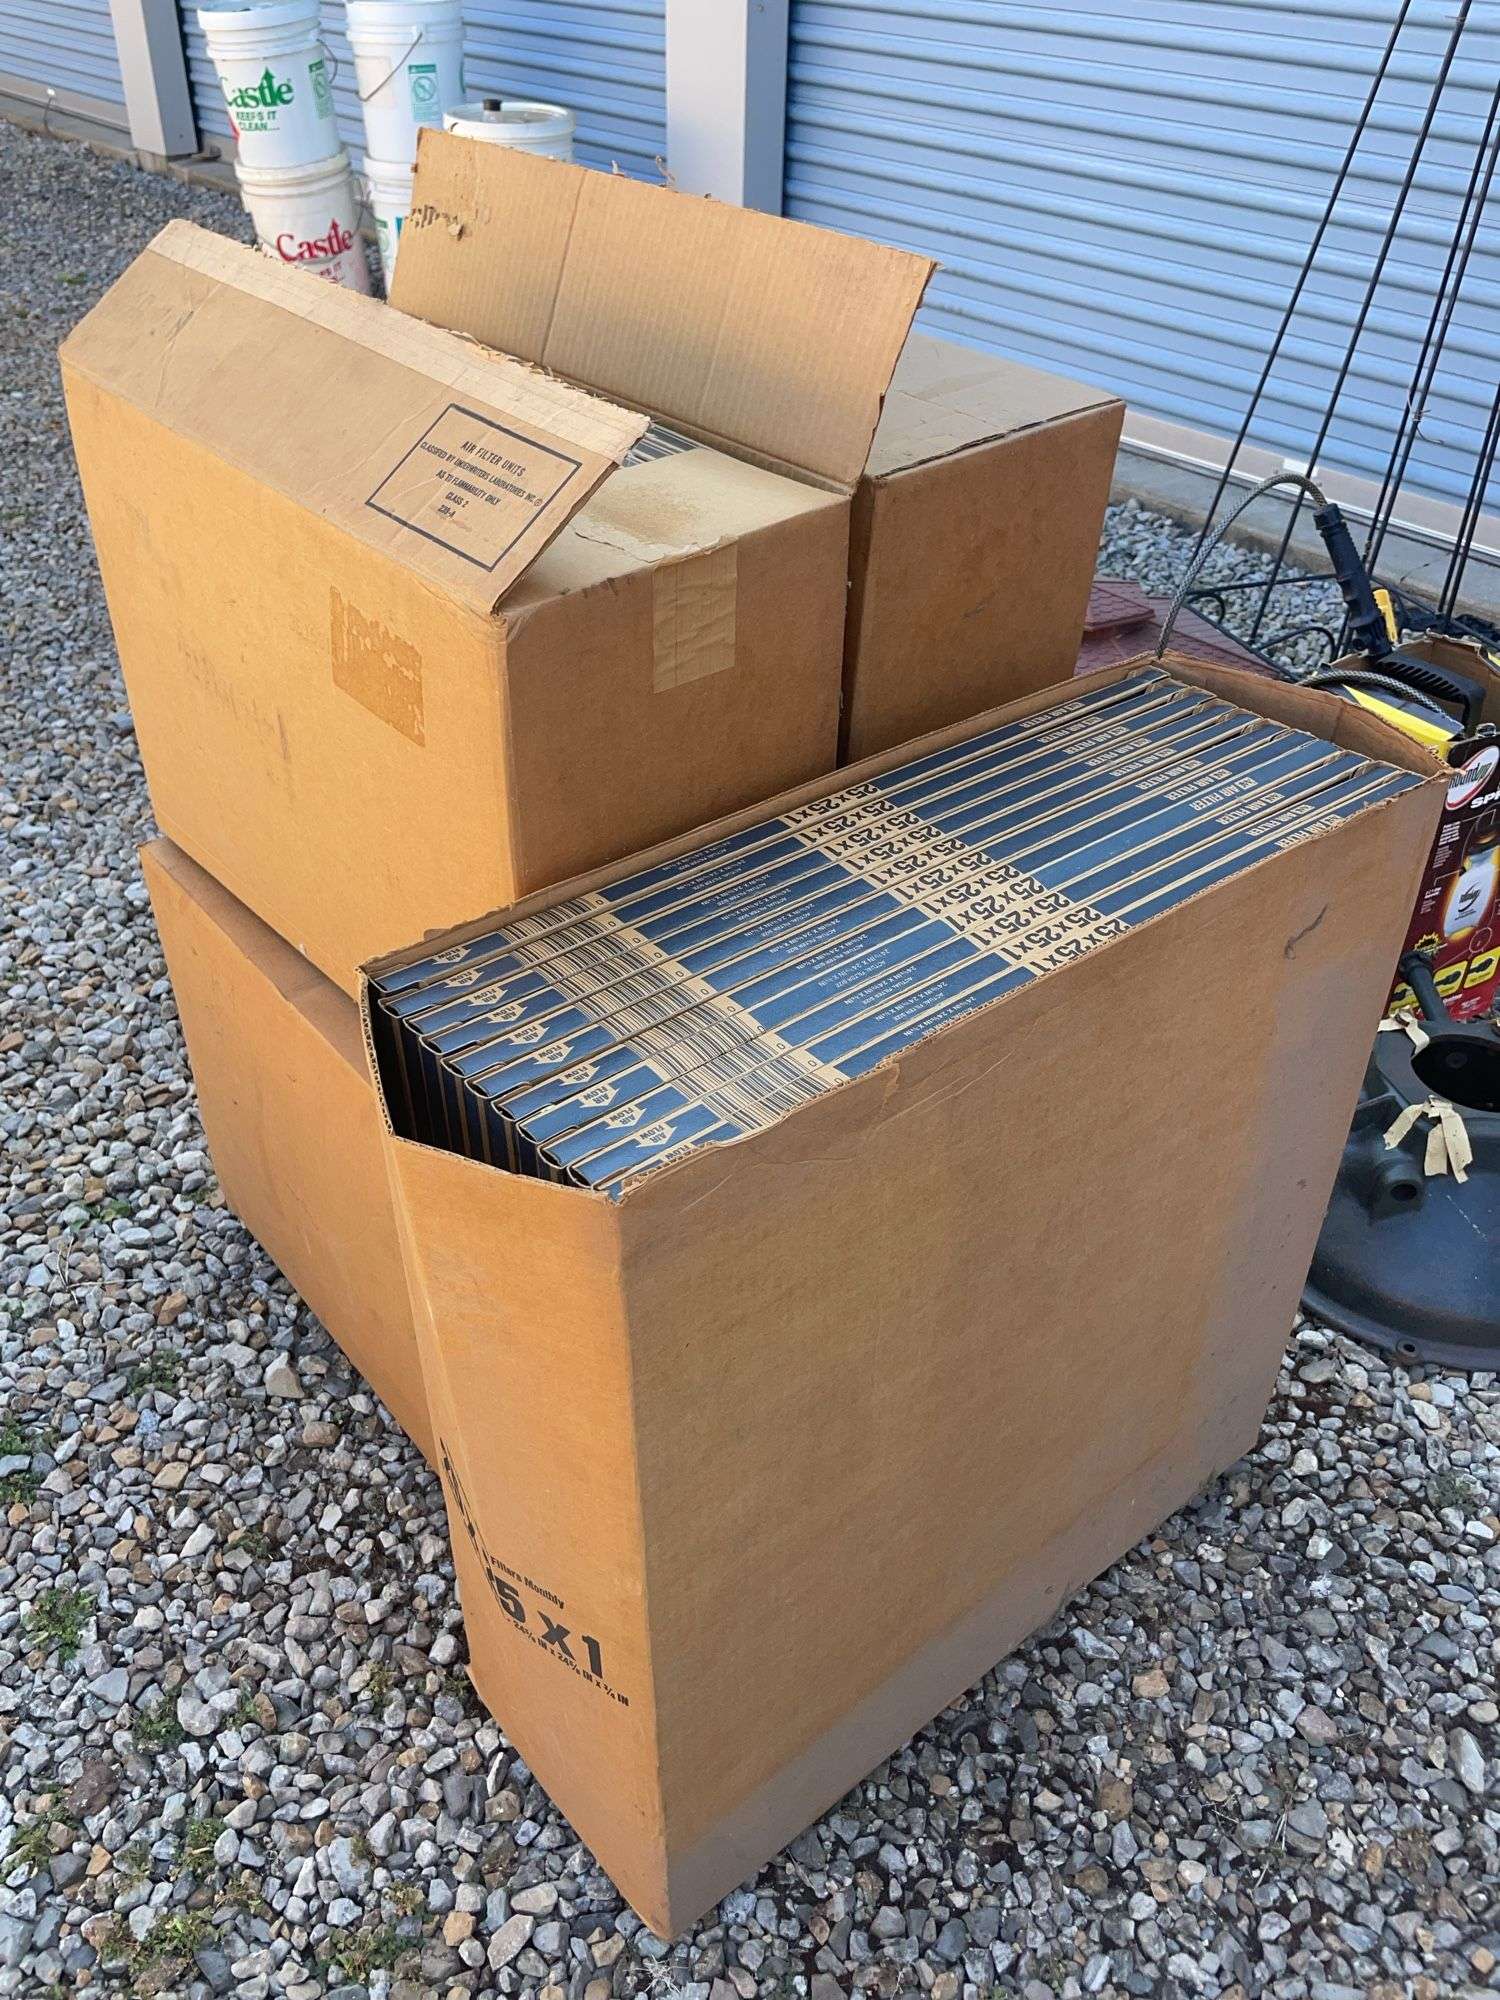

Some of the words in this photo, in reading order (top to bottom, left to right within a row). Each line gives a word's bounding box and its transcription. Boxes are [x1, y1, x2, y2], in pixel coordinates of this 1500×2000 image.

[277, 218, 352, 262] Castle
[461, 441, 477, 454] AIR
[475, 447, 503, 466] FILTER
[501, 459, 526, 477] UNITS
[420, 441, 448, 459] CLASSIFIED
[488, 475, 526, 498] LABORATORIES
[435, 469, 444, 480] AS
[452, 477, 487, 498] FLAMMABILITY
[485, 494, 501, 506] ONLY
[445, 491, 464, 505] CLASS
[1091, 732, 1113, 742] AIR
[1061, 739, 1096, 754] FILTER
[1163, 766, 1186, 776] AIR
[1134, 773, 1169, 789] FILTER
[1191, 776, 1216, 787] AIR
[1162, 783, 1199, 800] FILTER
[1216, 784, 1243, 796] AIR
[1186, 792, 1225, 810] FILTER
[1244, 800, 1267, 810] AIR
[1214, 807, 1251, 825] FILTER
[448, 971, 471, 982] FLOW
[457, 976, 472, 984] AIR
[491, 1005, 514, 1017] FLOW
[501, 1011, 516, 1019] AIR
[513, 1026, 537, 1038] FLOW
[522, 1032, 538, 1041] AIR
[537, 1045, 561, 1057] FLOW
[547, 1051, 563, 1060] AIR
[563, 1066, 587, 1079] FLOW
[573, 1071, 590, 1081] AIR
[581, 1086, 607, 1100] FLOW
[592, 1093, 609, 1103] AIR
[608, 1107, 633, 1121] FLOW
[619, 1114, 636, 1124] AIR
[638, 1124, 664, 1139] FLOW
[650, 1132, 666, 1142] AIR
[490, 1556, 522, 1582] Filters
[524, 1576, 564, 1610] Monthly
[582, 1635, 603, 1679] 1
[617, 1693, 629, 1706] IN
